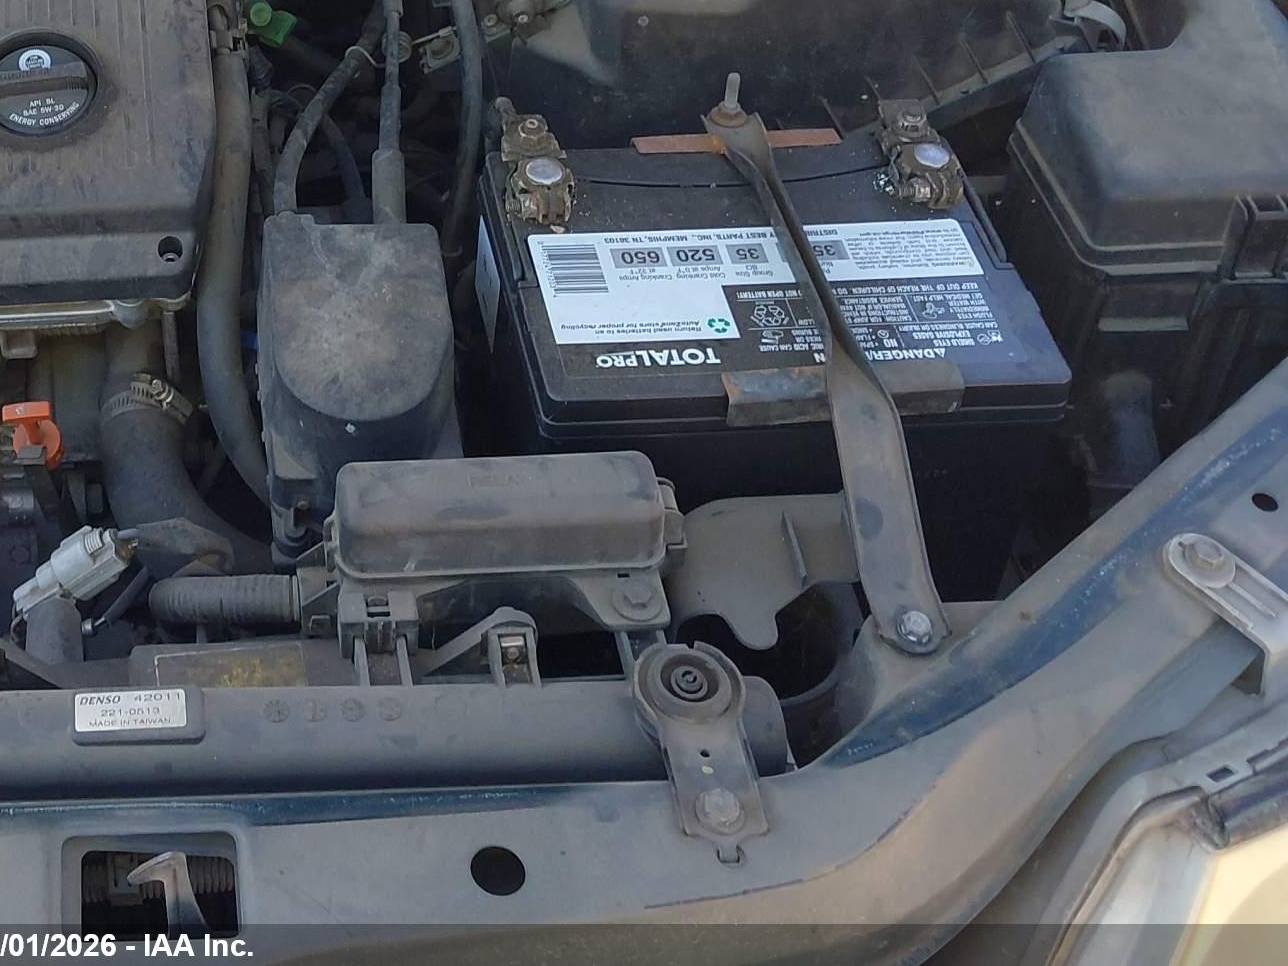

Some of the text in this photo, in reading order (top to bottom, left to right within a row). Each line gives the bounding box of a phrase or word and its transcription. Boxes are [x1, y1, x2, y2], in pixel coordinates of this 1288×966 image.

[9, 101, 79, 126] ENERGY CONSERVING
[621, 251, 659, 264] 650
[676, 248, 715, 262] 520
[736, 249, 760, 259] 35
[641, 272, 672, 280] Cranking
[767, 290, 783, 298] OPEN
[884, 339, 898, 347] NO
[596, 347, 721, 368] TOTALPRO
[80, 693, 180, 705] DENSO 42011
